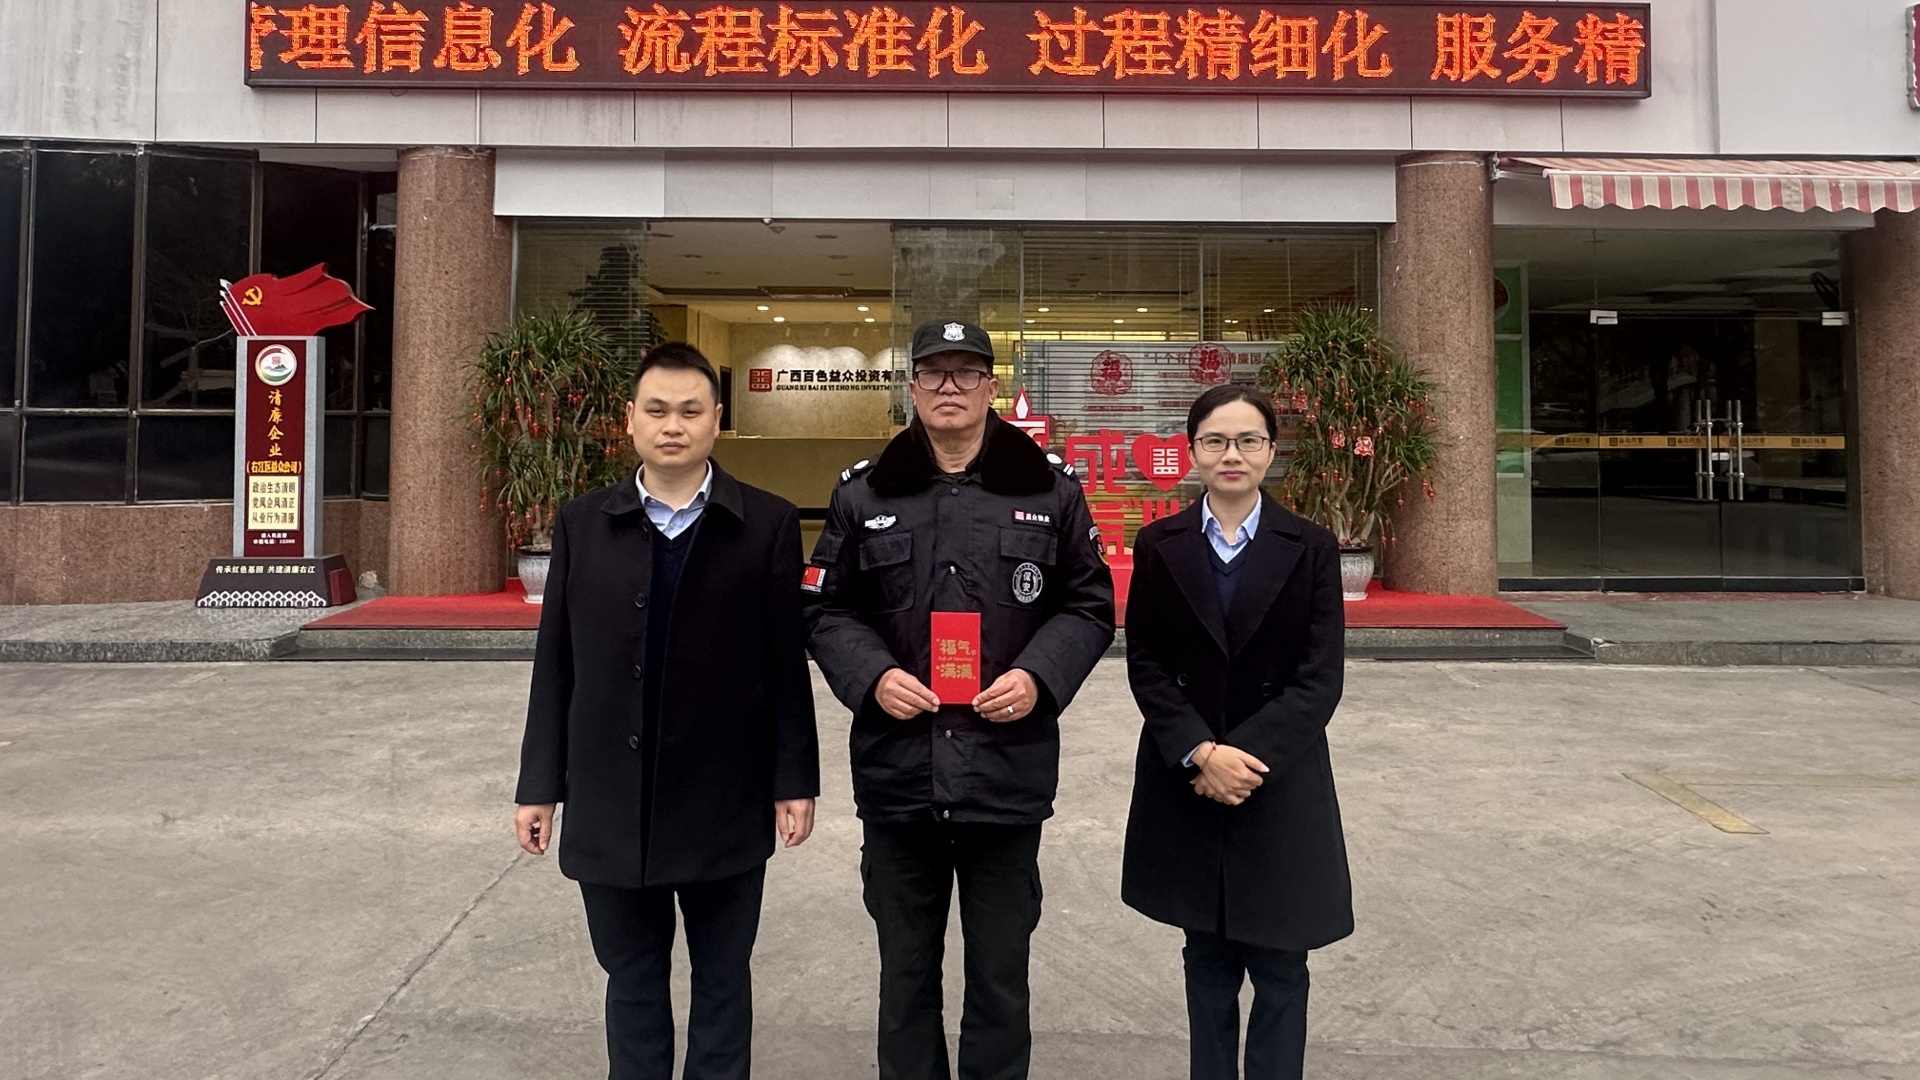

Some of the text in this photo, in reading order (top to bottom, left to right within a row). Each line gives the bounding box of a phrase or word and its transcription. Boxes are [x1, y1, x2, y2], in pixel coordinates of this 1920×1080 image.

[618, 3, 989, 78] 流程标准化
[1027, 7, 1393, 81] 过程精细化
[1431, 10, 1647, 84] 服务精
[776, 369, 907, 383] 广西百色益众投资有限
[267, 389, 284, 457] 清廉企业
[939, 639, 971, 655] 福气
[940, 663, 973, 680] 满满
